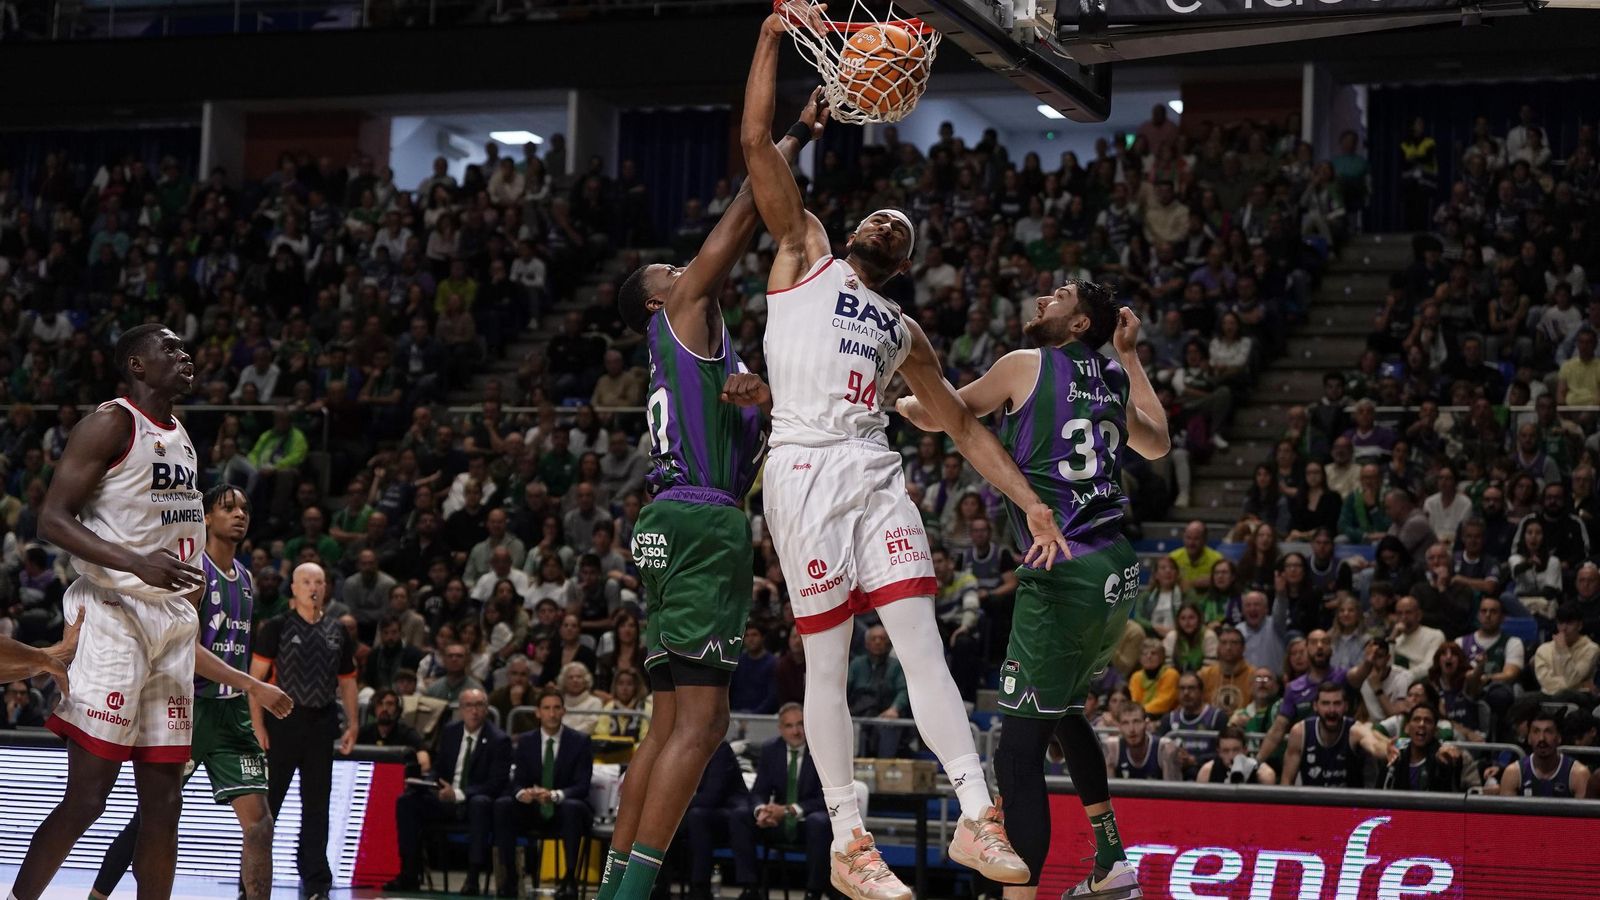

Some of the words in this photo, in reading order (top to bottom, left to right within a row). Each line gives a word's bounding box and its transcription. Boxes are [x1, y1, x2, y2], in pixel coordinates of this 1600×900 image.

[844, 370, 877, 411] 94
[151, 463, 197, 490] BAX
[887, 538, 913, 554] ETL
[890, 551, 930, 565] GLOBAL
[799, 575, 844, 597] unilabor
[86, 708, 131, 727] unilabor
[168, 707, 187, 719] ETL
